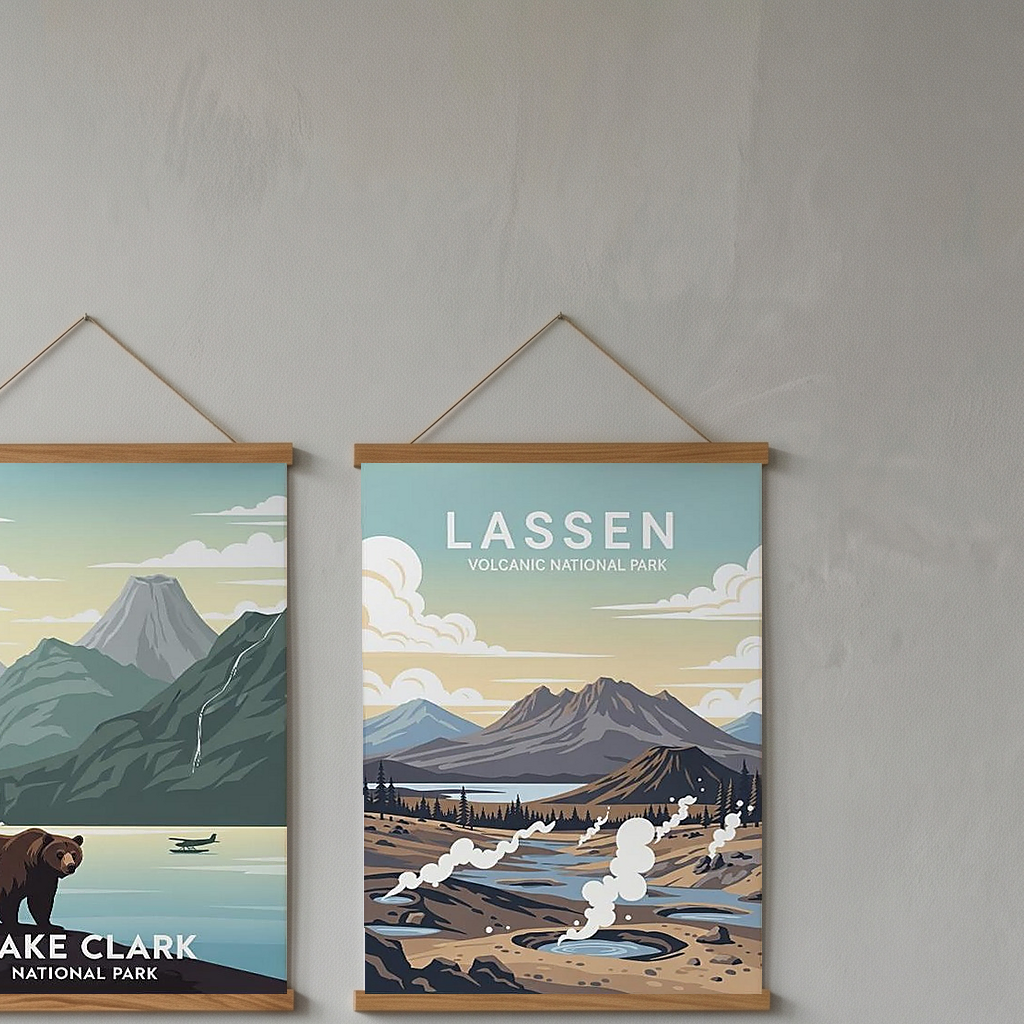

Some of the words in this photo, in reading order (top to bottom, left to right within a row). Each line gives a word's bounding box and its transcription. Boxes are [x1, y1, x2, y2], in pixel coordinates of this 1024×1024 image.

[446, 511, 674, 550] LASSEN
[467, 558, 546, 572] VOLCANIC
[550, 558, 626, 572] NATIONAL
[630, 558, 668, 572] PARK
[80, 933, 198, 960] CLARK
[11, 966, 106, 981] NATIONAL
[112, 966, 159, 981] PARK
